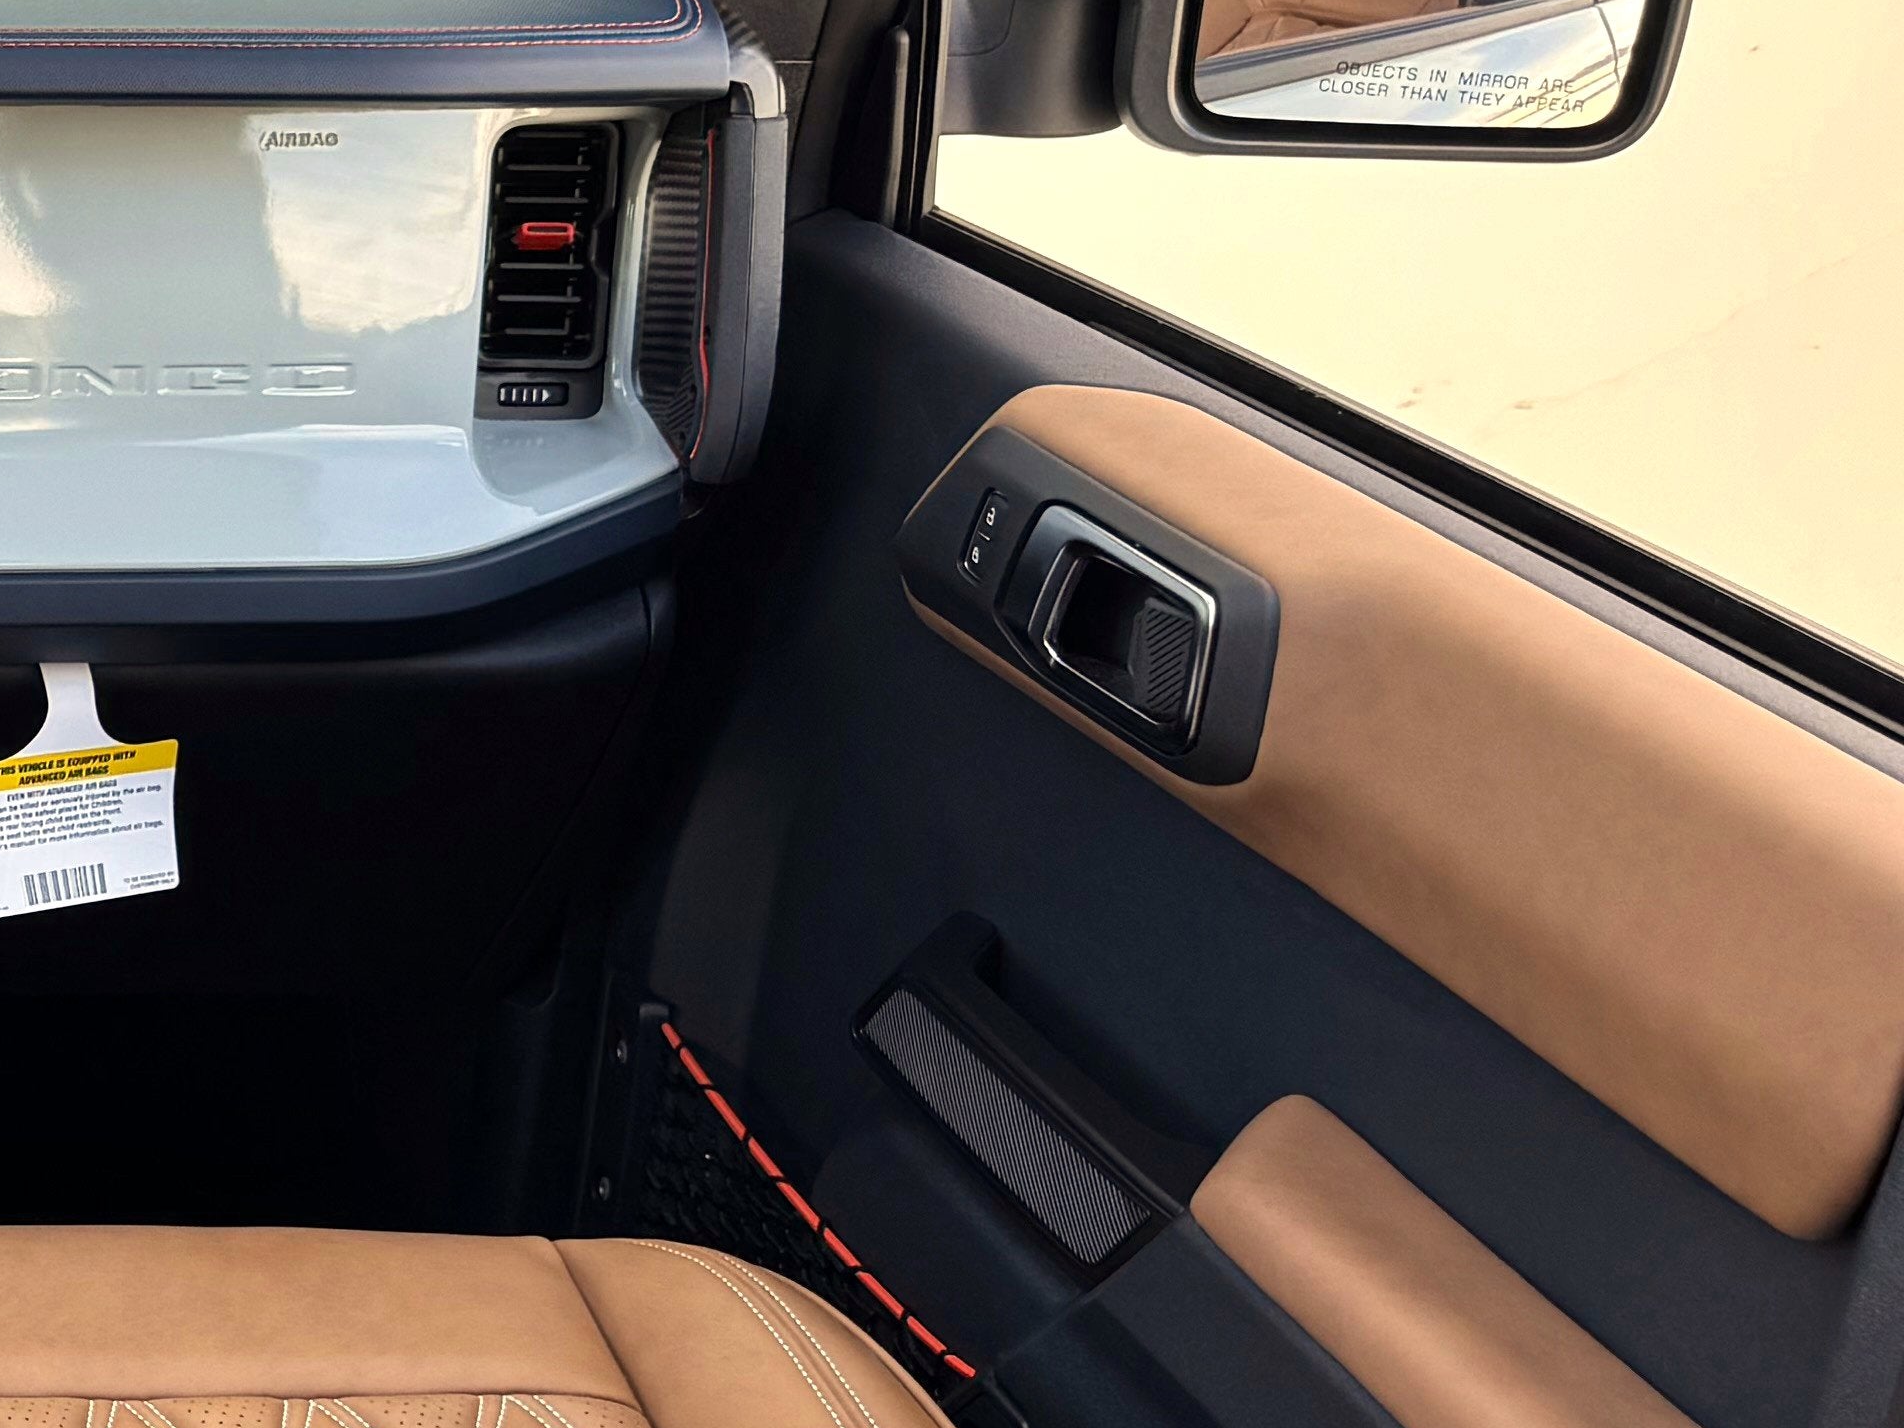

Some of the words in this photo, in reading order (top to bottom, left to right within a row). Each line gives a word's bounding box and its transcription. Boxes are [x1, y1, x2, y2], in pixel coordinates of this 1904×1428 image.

[1336, 61, 1418, 82] OBJECTS
[1429, 68, 1447, 83] IN
[1458, 72, 1529, 90] MIRROR
[1539, 77, 1575, 94] ARE
[1319, 78, 1389, 98] CLOSER
[1400, 85, 1448, 103] THAN
[1459, 89, 1506, 107] THEY
[1511, 94, 1585, 113] APPEAR
[18, 760, 54, 773] VEHICLE
[67, 753, 111, 767] EQUIPPED
[113, 750, 137, 760] WITH
[19, 771, 66, 786] ADVANCED
